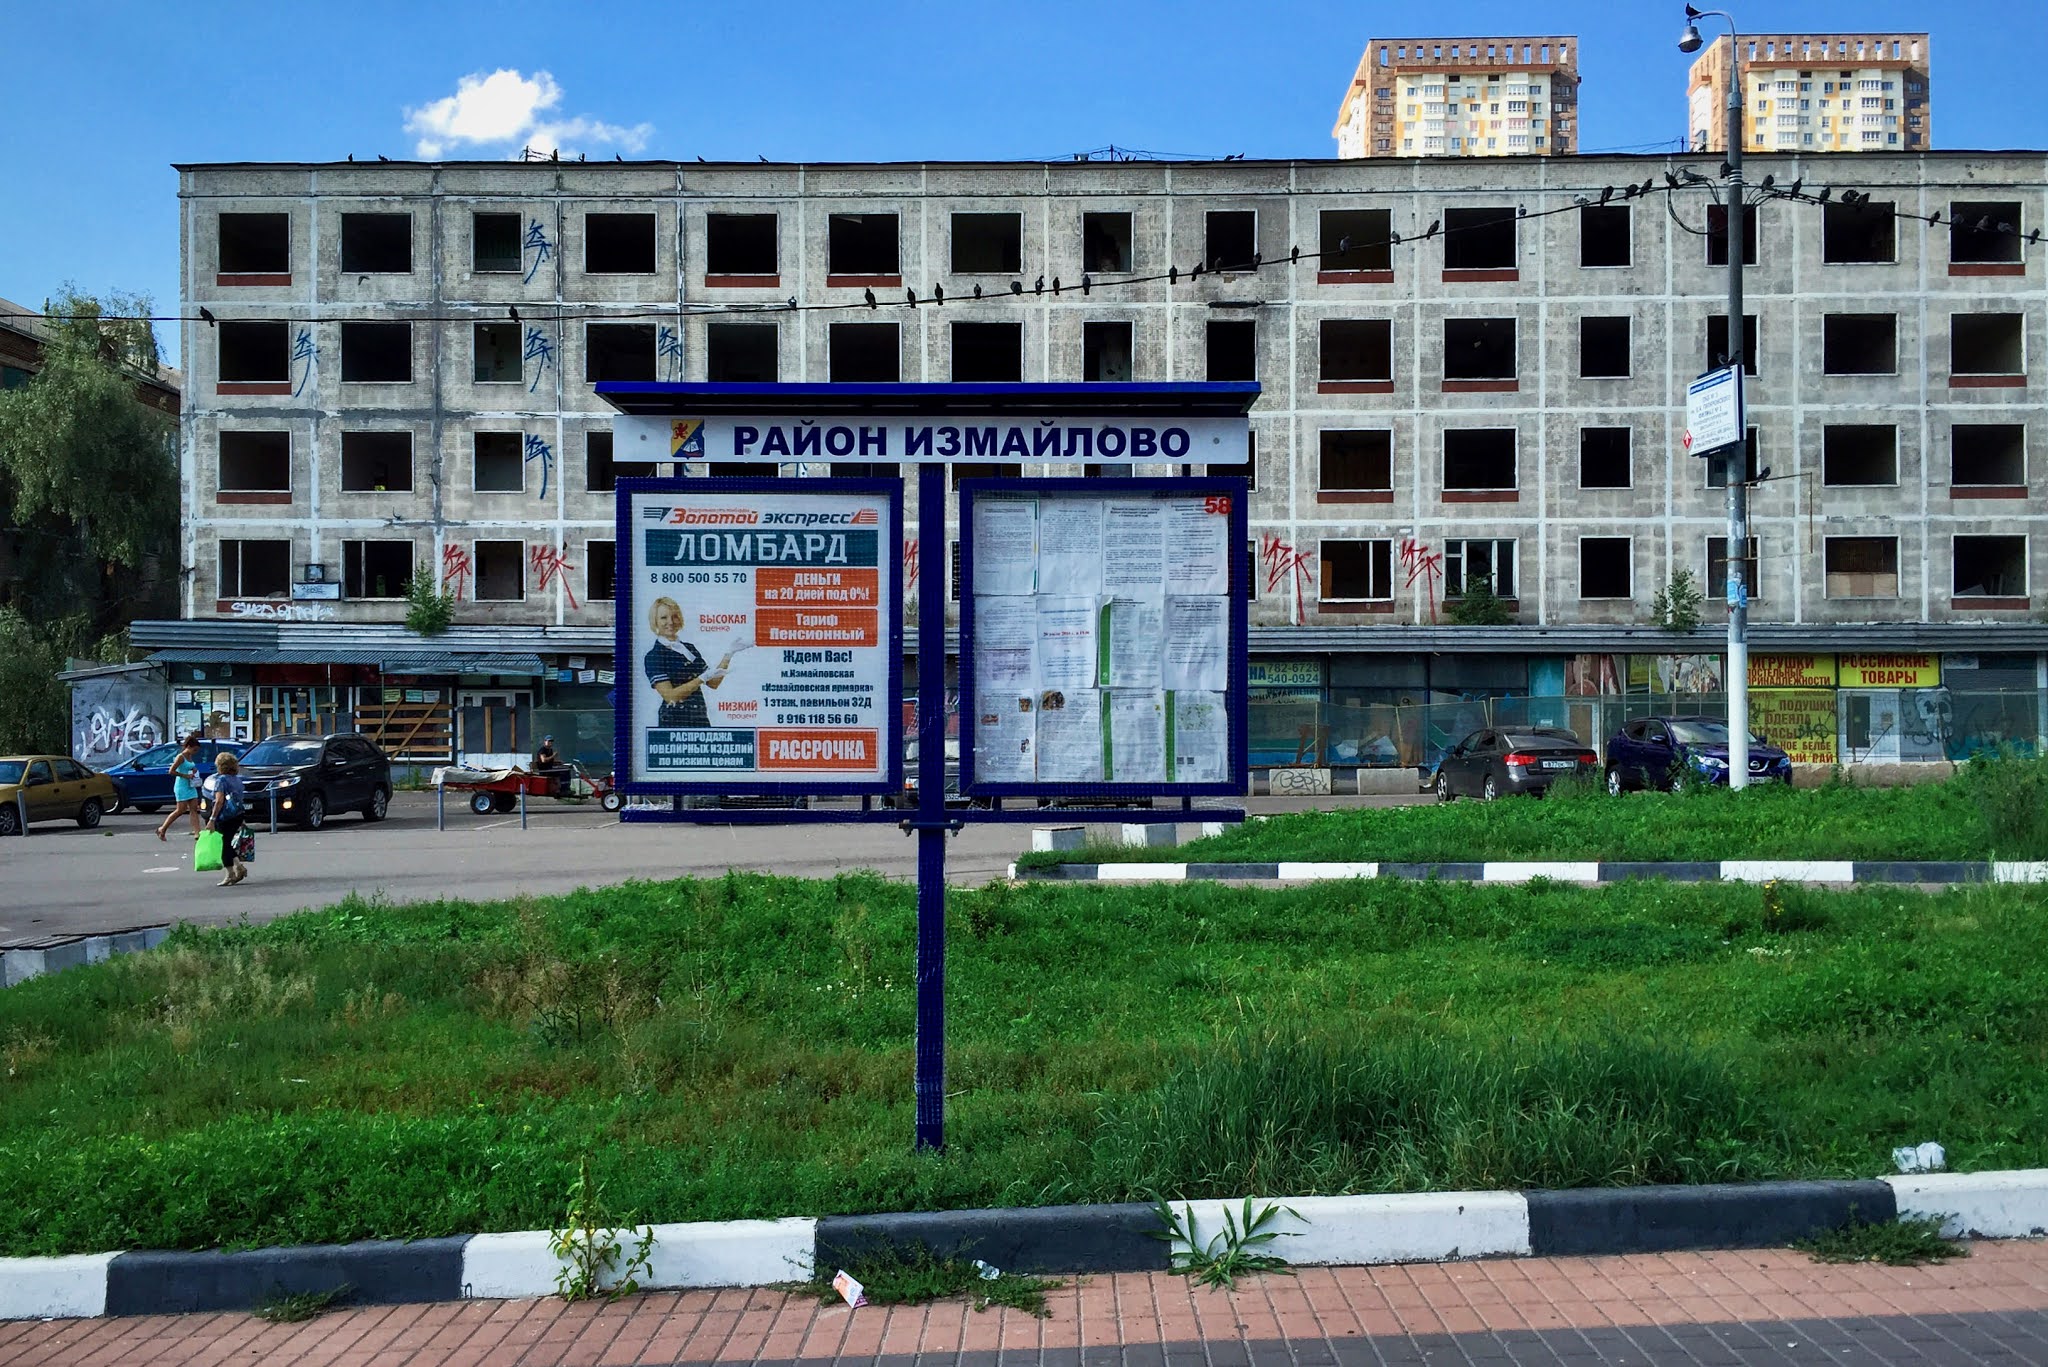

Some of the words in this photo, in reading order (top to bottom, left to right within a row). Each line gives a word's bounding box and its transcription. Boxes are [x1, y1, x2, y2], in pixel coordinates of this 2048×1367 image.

[734, 419, 888, 456] РАЙОН
[904, 420, 1191, 457] ИЗМАЙЛОВО
[1204, 496, 1232, 515] 58
[669, 507, 758, 525] Золотой
[762, 512, 851, 526] экспресс
[674, 533, 848, 564] ЛОМБАРД
[651, 573, 658, 584] 8
[662, 573, 684, 584] 800
[688, 573, 710, 584] 500
[714, 573, 729, 584] 55
[732, 573, 747, 584] 70
[793, 573, 841, 587] ДЕНЬГИ
[764, 589, 778, 600] на
[780, 588, 794, 600] 20
[795, 587, 824, 601] дней
[826, 589, 848, 601] под
[850, 588, 869, 600] 0%!
[699, 614, 747, 624] ВЫСОКАЯ
[796, 613, 838, 627] Тариф
[769, 628, 865, 641] Пенсионный
[783, 650, 822, 664] Ждем
[825, 650, 853, 663] Вас!
[1752, 656, 1815, 669] ИГРУШКИ
[1268, 663, 1319, 673] 782-6728
[1267, 674, 1319, 683] 540-0924
[1861, 671, 1917, 684] ТОВАРЫ
[718, 700, 758, 712] НИЗКИЙ
[764, 697, 769, 707] 1
[770, 698, 798, 708] этаж,
[800, 699, 850, 708] павильон
[851, 697, 872, 709] 32Д
[1779, 700, 1835, 712] ПОДУШКИ
[777, 713, 784, 724] 8
[786, 713, 806, 724] 916
[807, 713, 825, 724] 118
[827, 713, 842, 724] 56
[844, 713, 858, 724] 60
[1765, 713, 1811, 725] ОДЕЯЛА
[669, 731, 733, 743] РАСПРОДАЖА
[649, 744, 710, 754] ЮВЕЛИРНЫХ
[710, 742, 754, 755] ИЗДЕЛИЙ
[769, 739, 866, 761] РАССРОЧКА
[658, 757, 671, 766] по
[672, 757, 711, 766] низким
[712, 757, 744, 767] ценам
